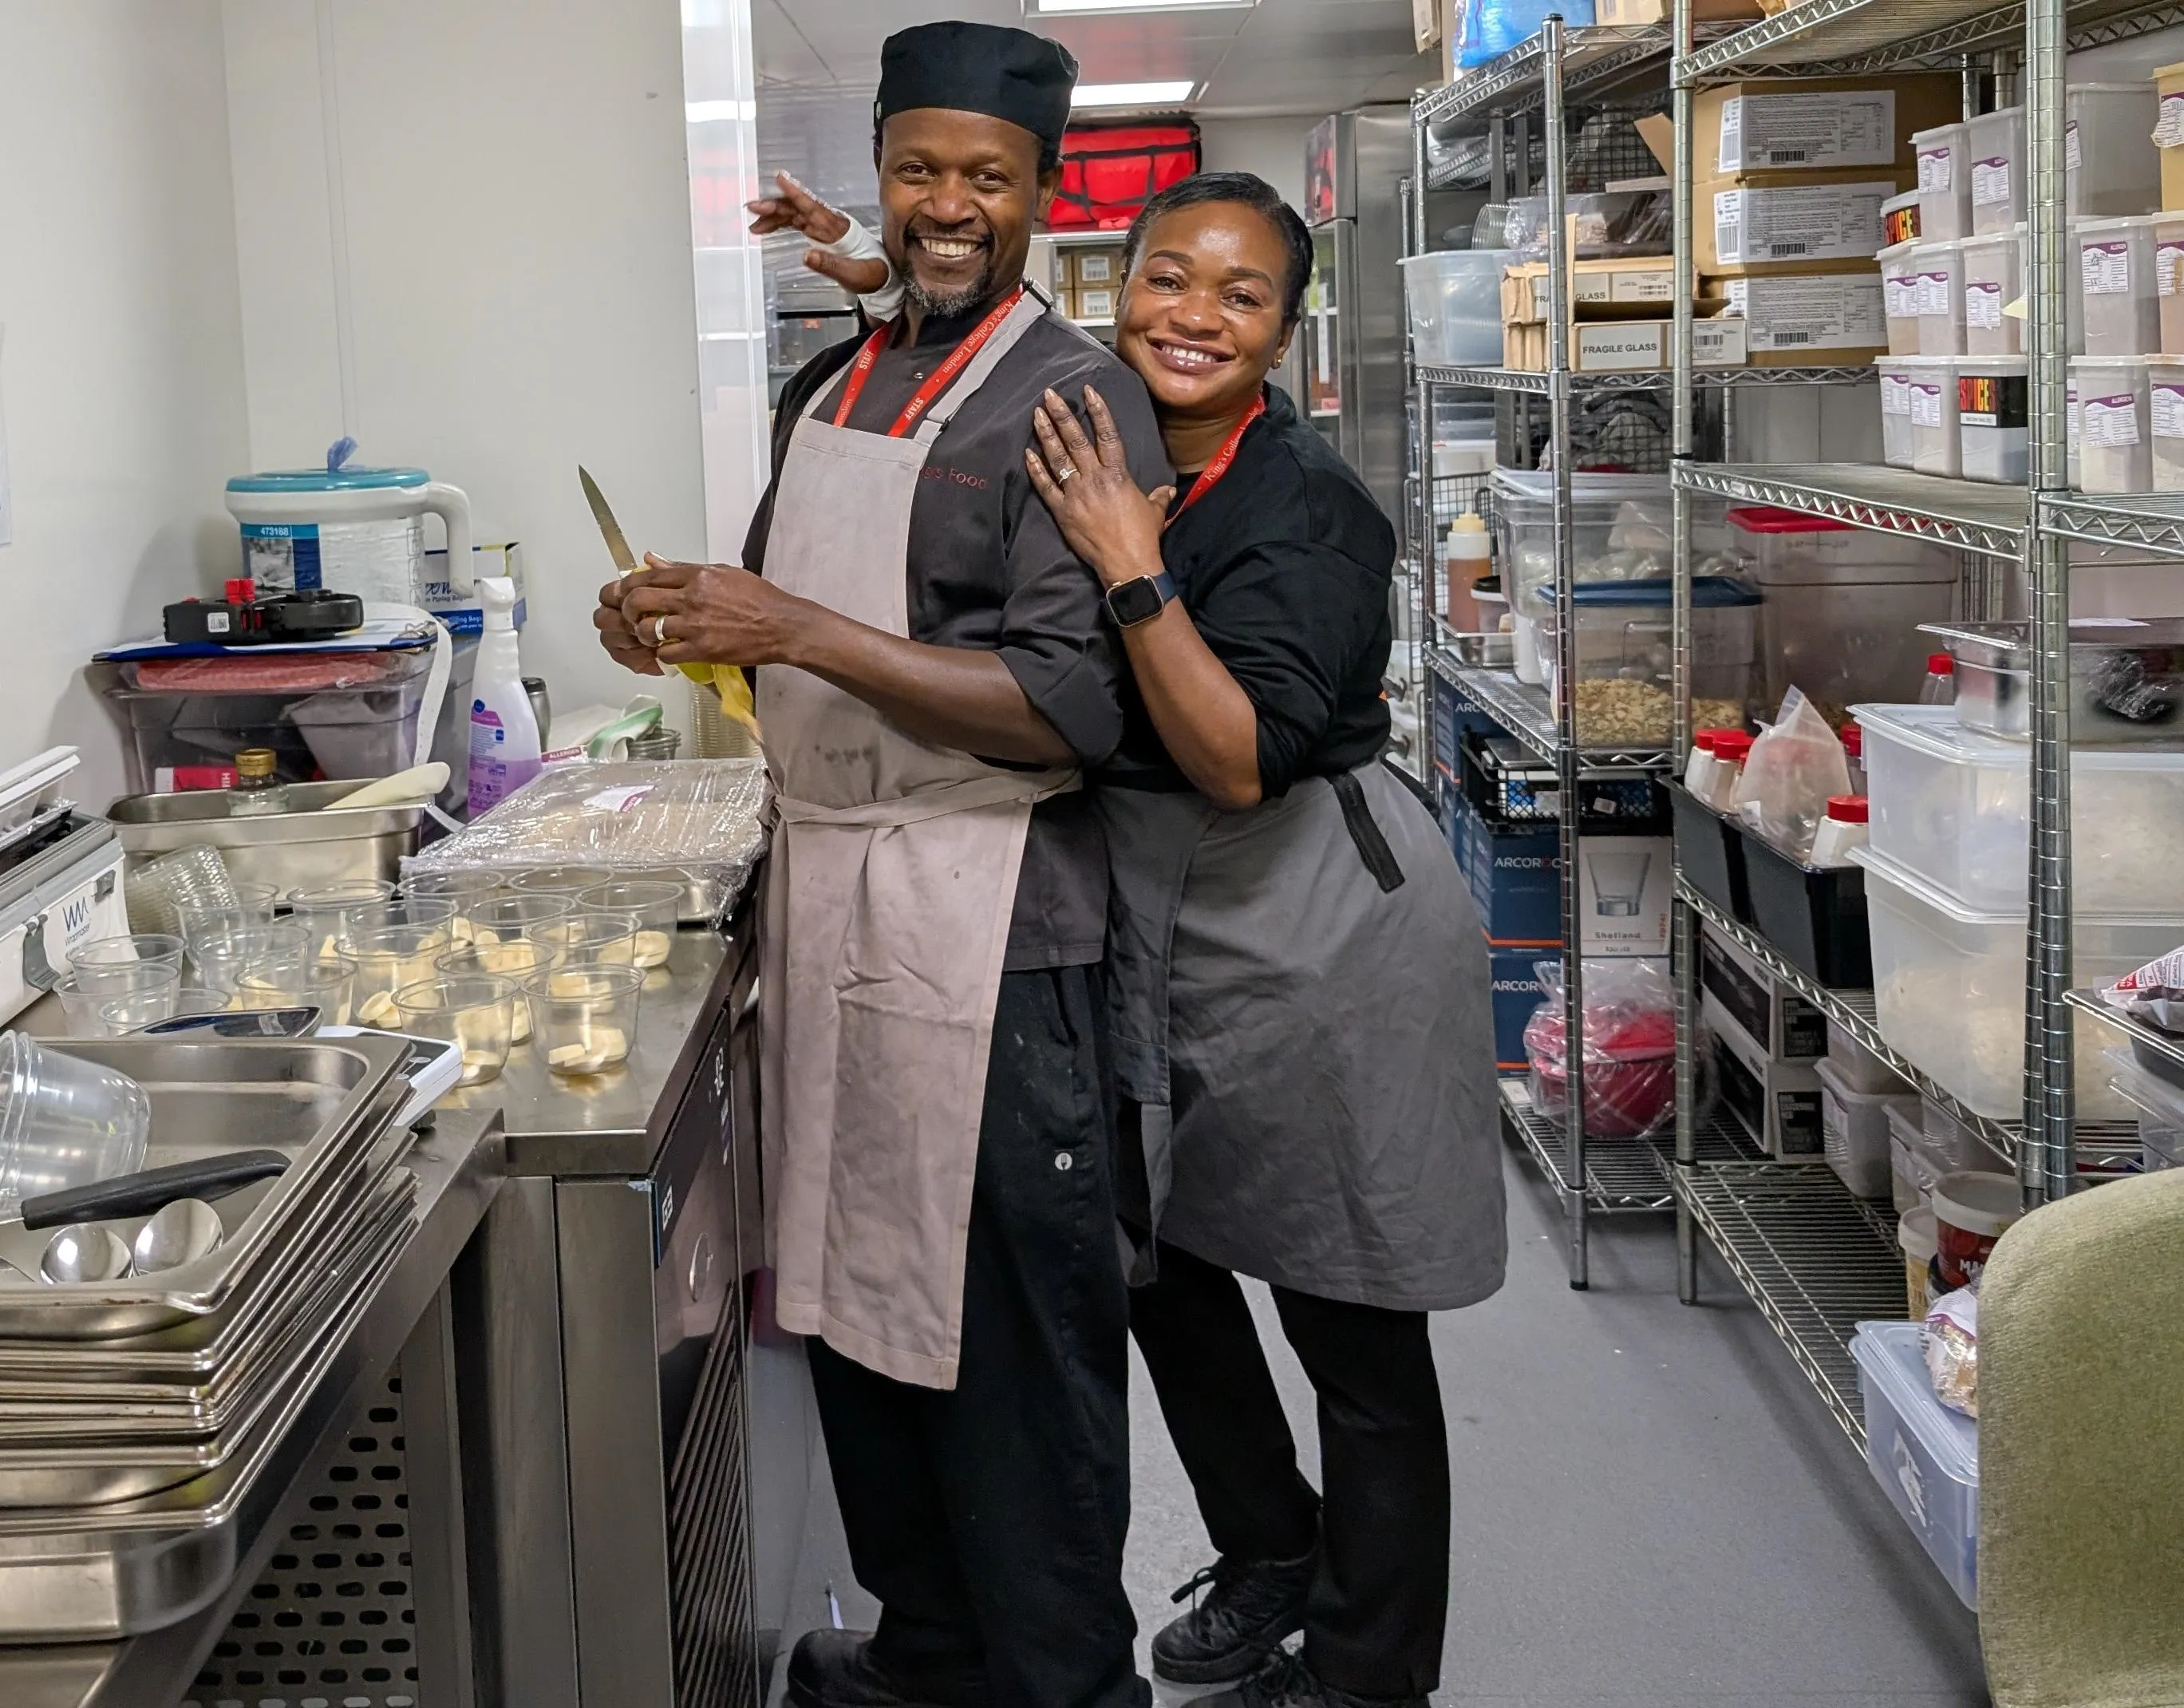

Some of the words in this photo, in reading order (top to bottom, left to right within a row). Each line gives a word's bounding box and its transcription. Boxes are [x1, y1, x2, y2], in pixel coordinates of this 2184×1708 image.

[1575, 291, 1605, 302] GLASS
[968, 322, 994, 347] College
[859, 348, 875, 370] STAFF
[1582, 345, 1623, 354] FRAGILE
[1625, 342, 1657, 352] GLASS
[942, 347, 972, 374] London
[1960, 378, 1997, 412] SPICES
[904, 397, 924, 421] STAFF
[948, 468, 988, 490] Food
[1491, 980, 1539, 991] ARCOR
